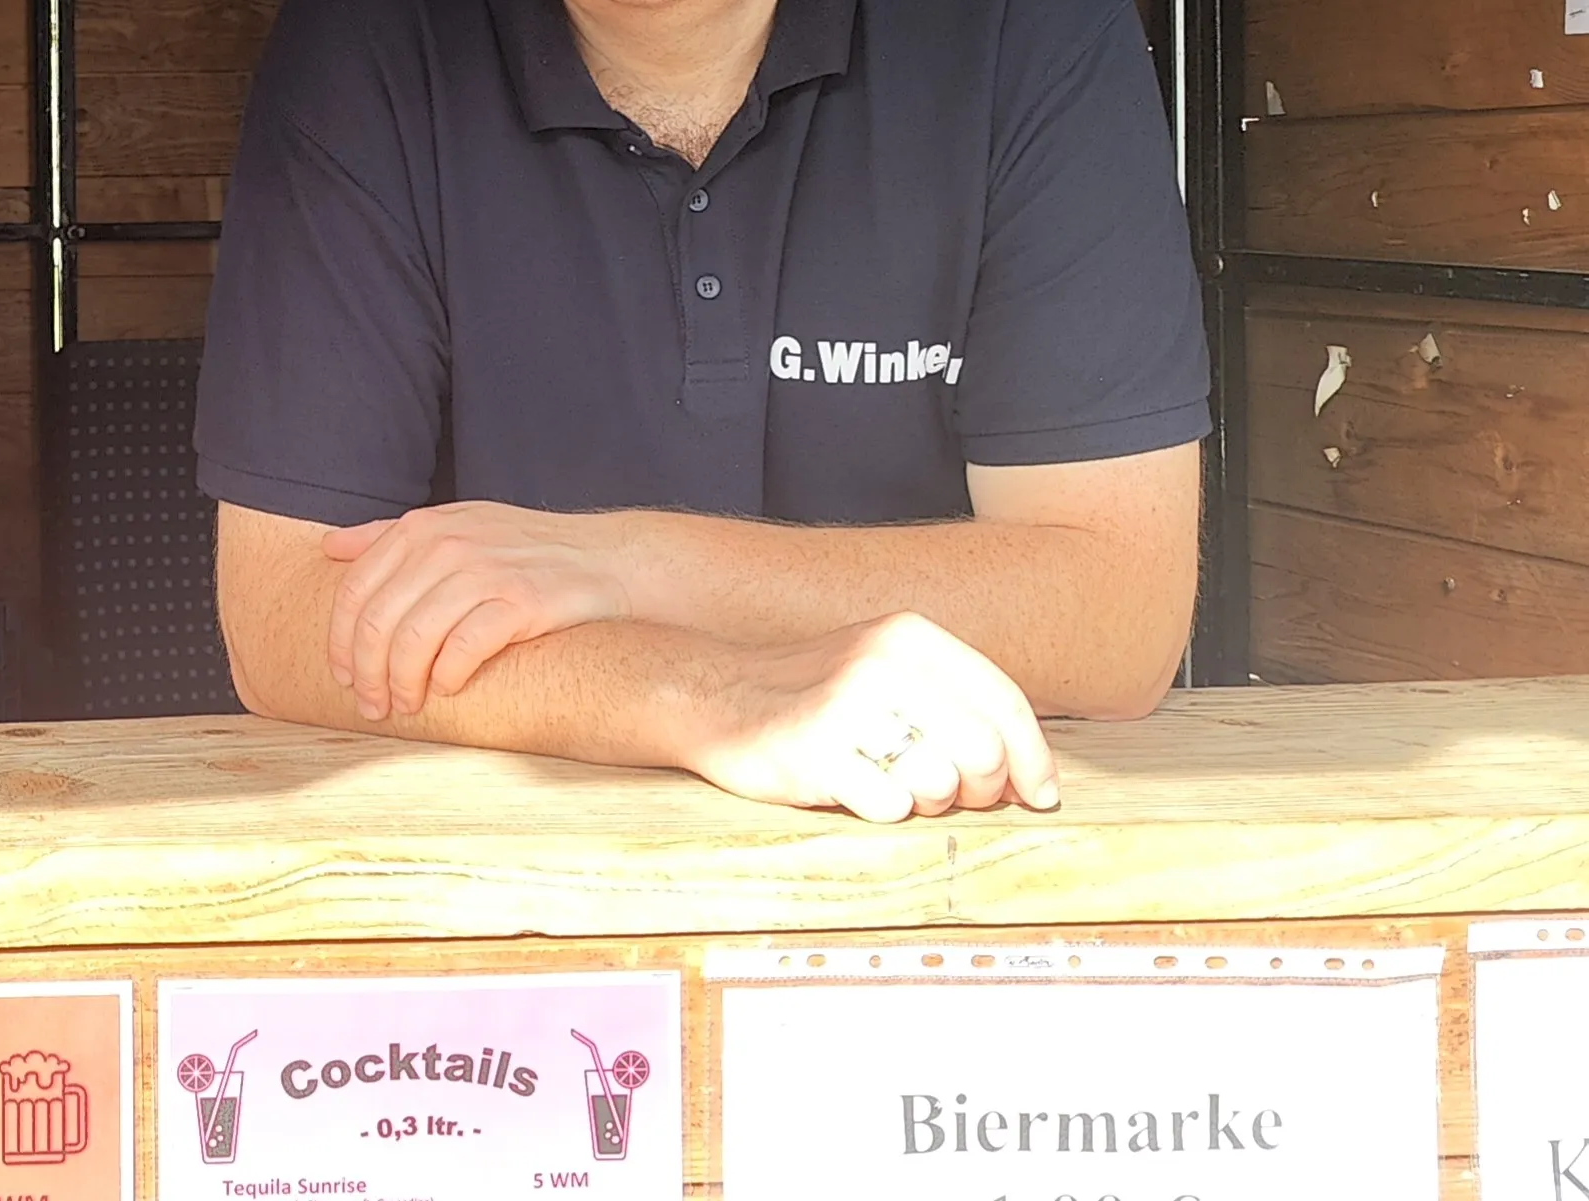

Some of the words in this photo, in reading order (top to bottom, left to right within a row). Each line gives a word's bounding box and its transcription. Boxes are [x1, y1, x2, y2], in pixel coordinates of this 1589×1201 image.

[280, 1043, 538, 1099] Cocktails
[377, 1115, 418, 1141] 0,3
[427, 1115, 464, 1137] ltr.
[900, 1094, 1282, 1155] Biermarke
[223, 1178, 292, 1201] Tequila
[298, 1176, 366, 1194] Sunrise
[533, 1173, 543, 1189] 5
[550, 1171, 589, 1188] WM
